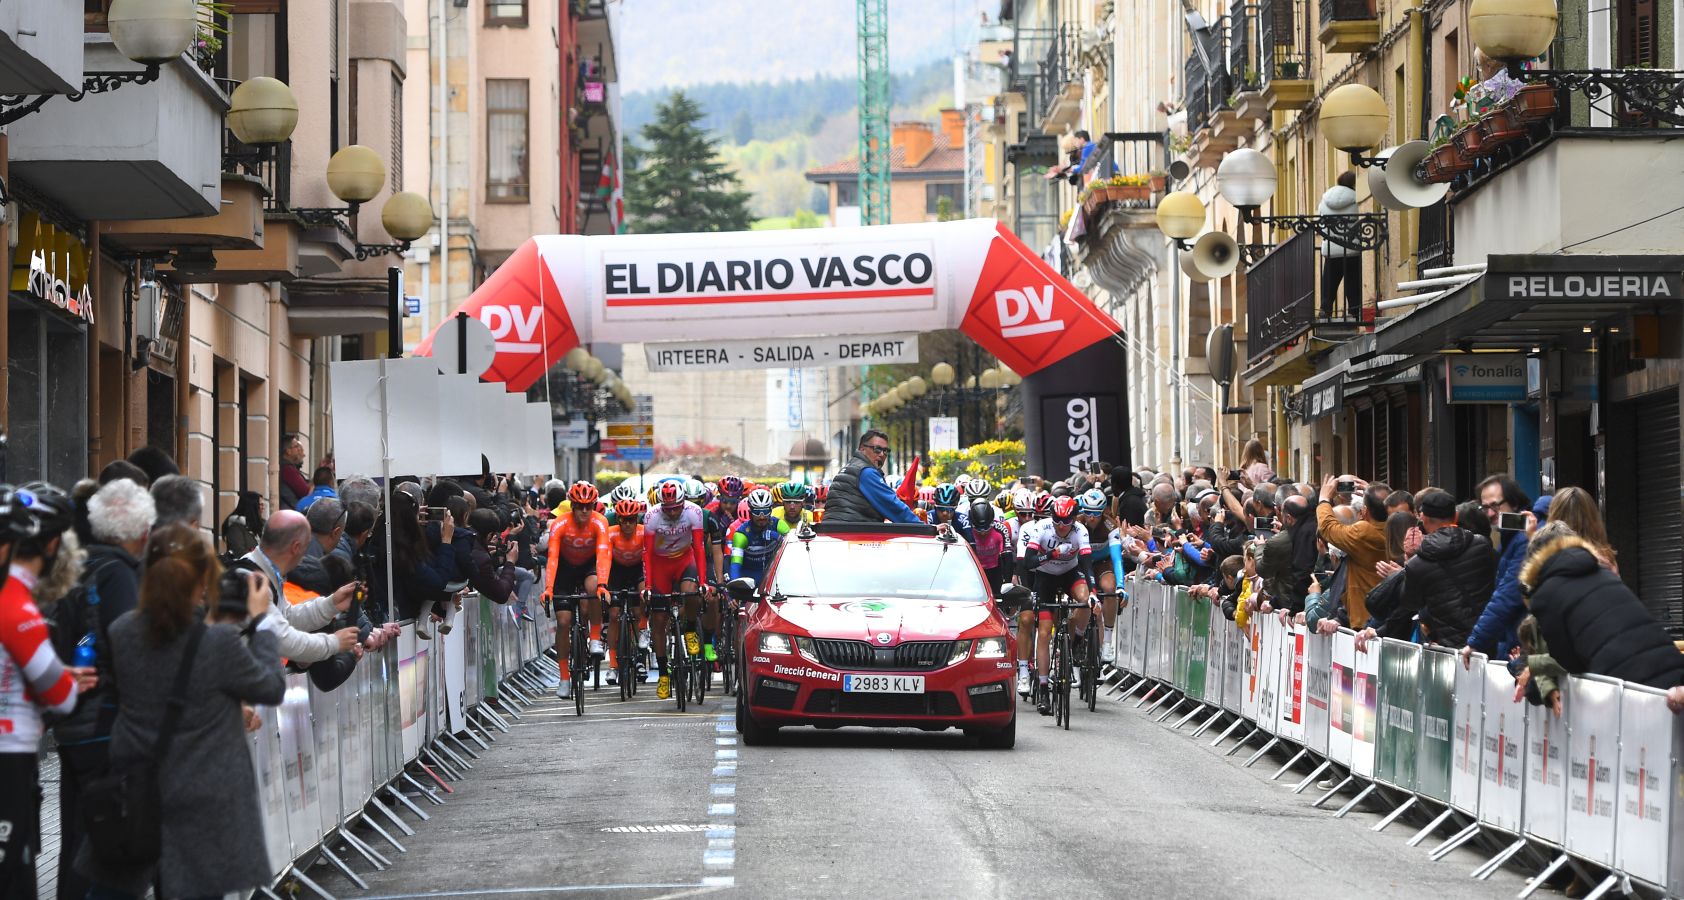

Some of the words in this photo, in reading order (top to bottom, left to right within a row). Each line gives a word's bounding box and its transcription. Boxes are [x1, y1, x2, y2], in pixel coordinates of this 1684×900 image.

[605, 263, 651, 295] EL
[657, 258, 795, 294] DIARIO
[800, 252, 933, 289] VASCO
[1508, 275, 1672, 298] RELOJERIA
[994, 284, 1054, 327] DV
[479, 304, 543, 342] DV
[657, 348, 730, 366] IRTEERA
[753, 345, 815, 363] SALIDA
[838, 341, 905, 359] DEPART
[1471, 364, 1523, 378] fonalia
[1066, 398, 1092, 473] ASCO
[774, 664, 805, 677] Direcció
[805, 667, 840, 682] General
[854, 677, 889, 691] 2983
[893, 678, 920, 691] KLV
